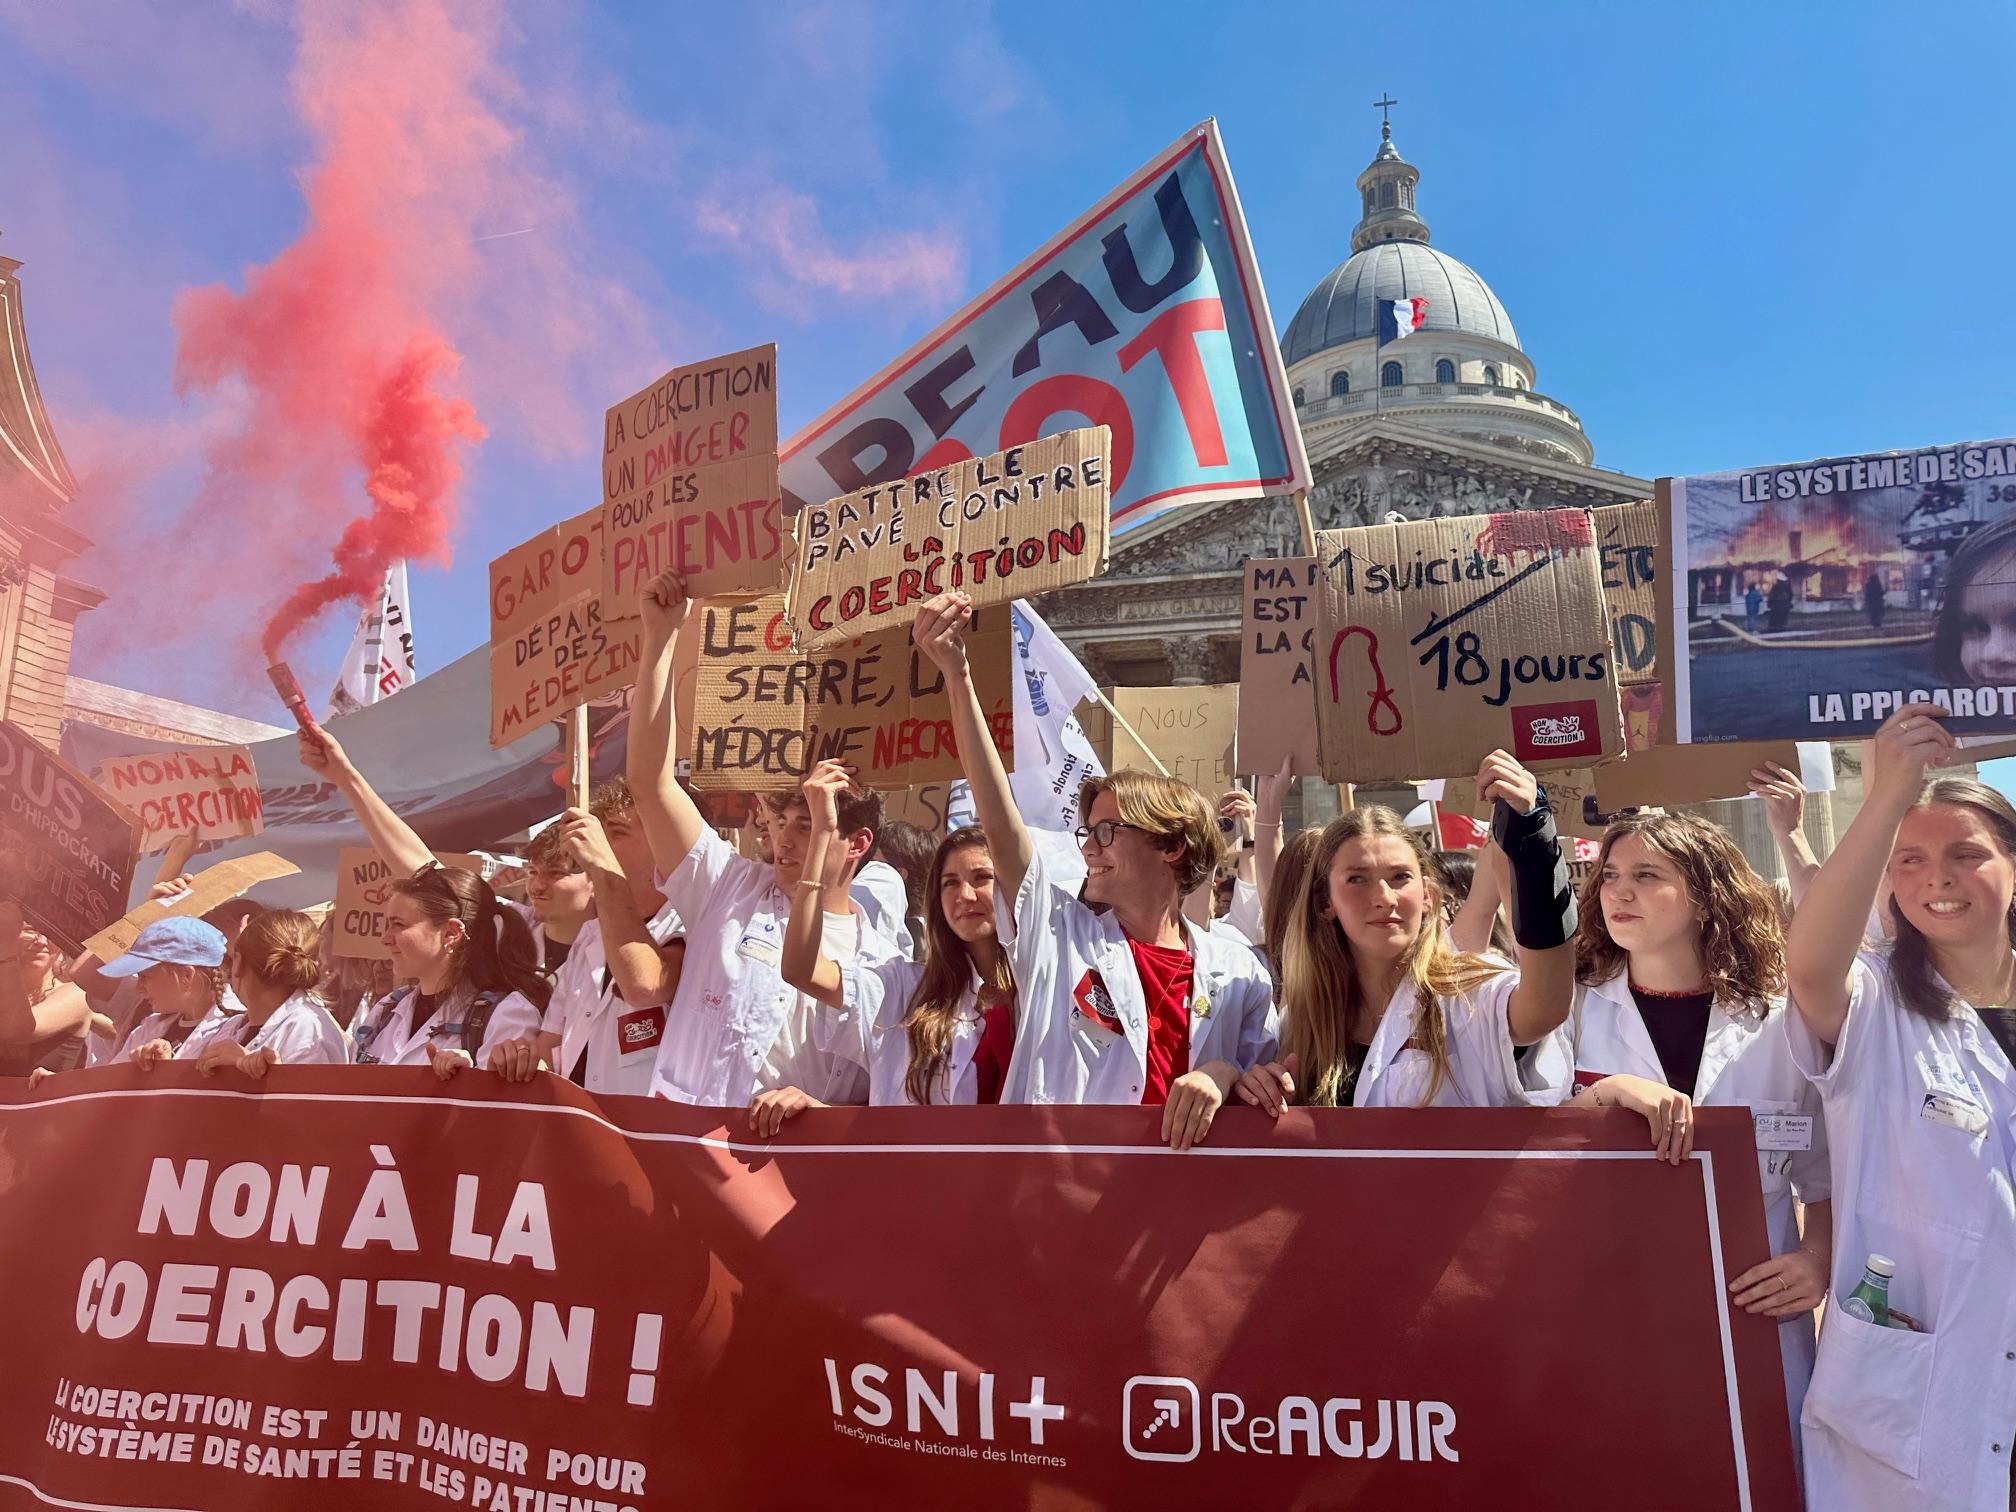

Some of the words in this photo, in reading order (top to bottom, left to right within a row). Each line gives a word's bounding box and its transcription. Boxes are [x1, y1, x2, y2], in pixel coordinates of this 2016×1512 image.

[607, 413, 626, 453] LA
[634, 360, 772, 441] COERCITION
[608, 463, 636, 498] UN
[645, 411, 751, 486] DANGER
[1741, 473, 1771, 503] LE
[1777, 456, 1911, 500] SYSTÈME
[1917, 450, 1959, 485] DE
[612, 492, 653, 531] POUR
[663, 473, 699, 506] LES
[807, 511, 903, 572] PAVÉ
[939, 457, 1103, 529] CONTRE
[811, 471, 956, 540] BATTRE
[977, 448, 1023, 484] LE
[614, 499, 782, 597] PATIENTS
[904, 536, 943, 562] LA
[1329, 547, 1358, 595] 1
[1254, 567, 1295, 590] MA
[703, 604, 758, 657] LE
[1253, 596, 1307, 622] EST
[554, 626, 607, 667] DES
[1255, 631, 1291, 654] LA
[1419, 631, 1490, 691] 18
[720, 643, 895, 709] SERRÉ,
[1138, 702, 1209, 732] NOUS
[1532, 720, 1547, 729] NON
[1809, 693, 1846, 722] LA
[1852, 690, 1903, 721] PPI
[1533, 733, 1578, 744] COERCITION
[112, 757, 184, 791] NON
[214, 753, 252, 778] LA
[138, 1157, 330, 1246] NON
[341, 1144, 419, 1251] À
[450, 1173, 557, 1271] LA
[75, 1257, 595, 1398] COERCITION
[627, 1312, 663, 1406] !
[70, 1384, 252, 1431] COERCITION
[262, 1406, 328, 1439] EST
[351, 1410, 401, 1441] UN
[417, 1416, 528, 1475] DANGER
[546, 1448, 647, 1496] POUR
[834, 1420, 911, 1450] InterSyndicale
[915, 1439, 978, 1460] Nationale
[982, 1447, 1007, 1462] des
[1010, 1449, 1067, 1468] Internes
[1211, 1392, 1459, 1463] ReAGJIR
[56, 1421, 195, 1463] SYSTÈME
[202, 1435, 241, 1470] DE
[244, 1441, 362, 1478] SANTÉ
[373, 1449, 414, 1483] ET
[419, 1458, 465, 1501] LES
